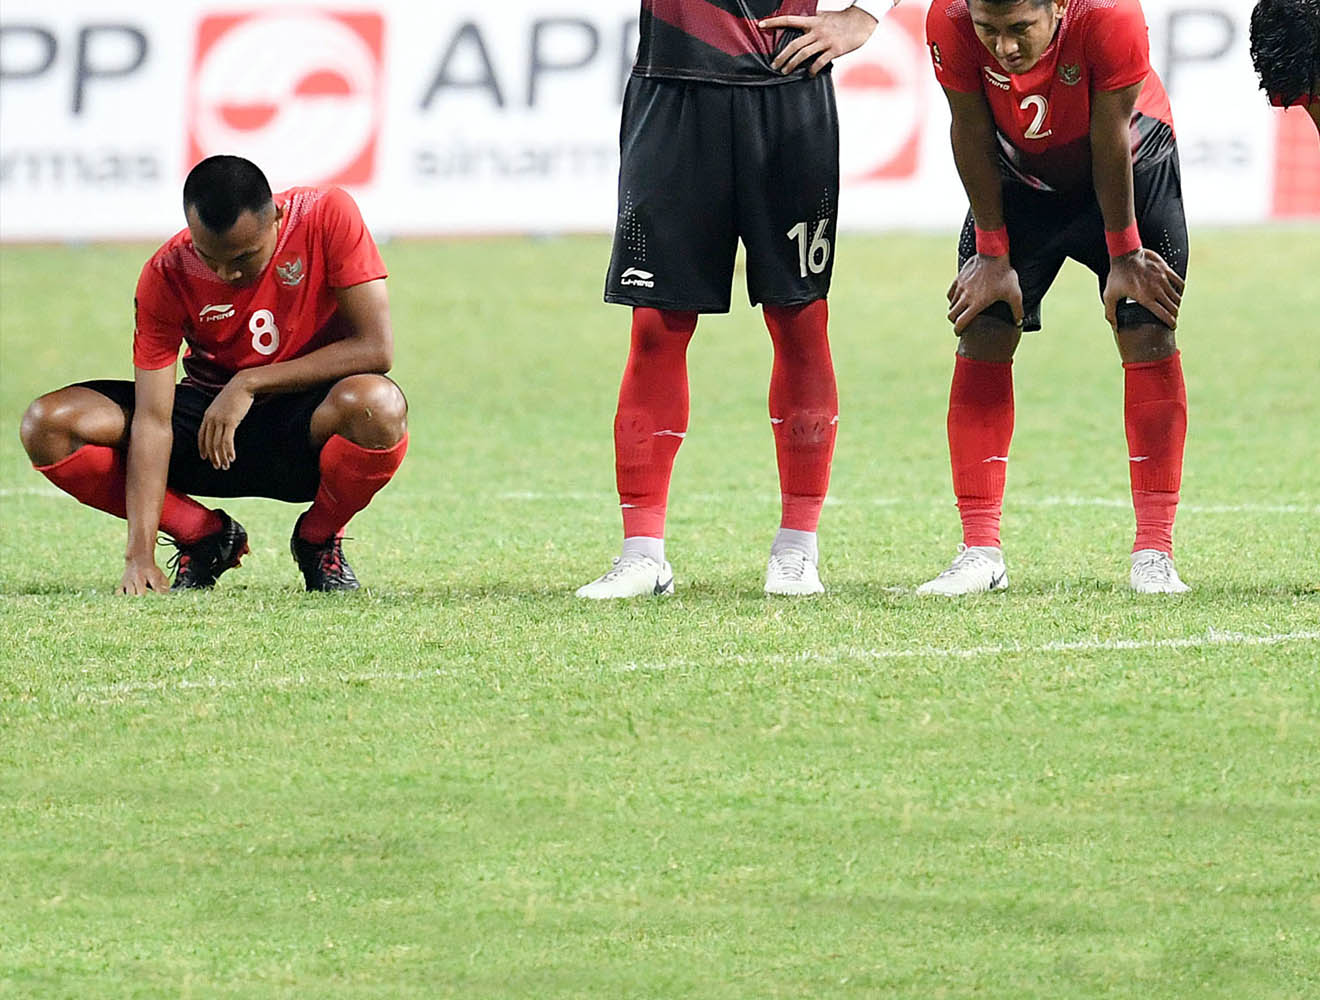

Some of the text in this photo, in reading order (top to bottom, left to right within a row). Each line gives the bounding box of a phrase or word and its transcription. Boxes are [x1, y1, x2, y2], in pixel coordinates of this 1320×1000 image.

[1019, 94, 1053, 140] 2
[786, 217, 831, 279] 16
[248, 308, 281, 356] 8
